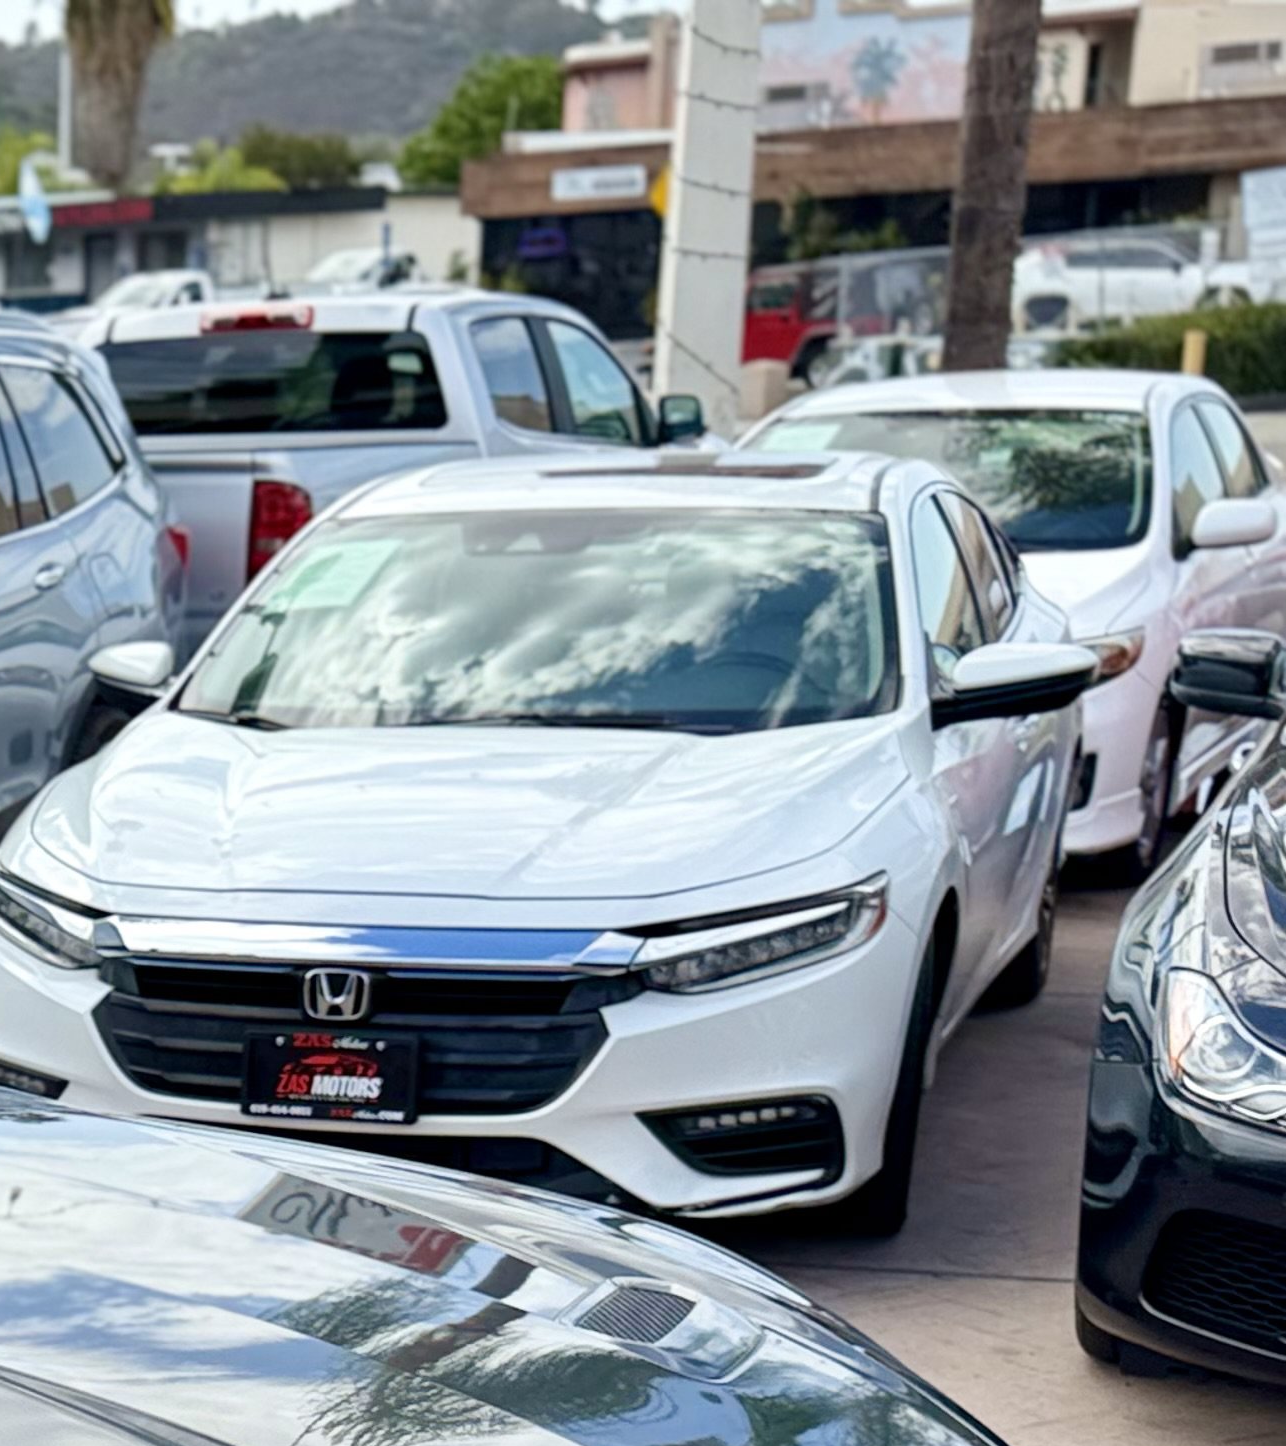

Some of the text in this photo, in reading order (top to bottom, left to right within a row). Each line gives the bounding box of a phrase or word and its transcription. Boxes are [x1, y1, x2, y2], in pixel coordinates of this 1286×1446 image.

[292, 1033, 331, 1047] ZAS
[276, 1073, 310, 1093] ZAS
[310, 1074, 383, 1099] MOTORS
